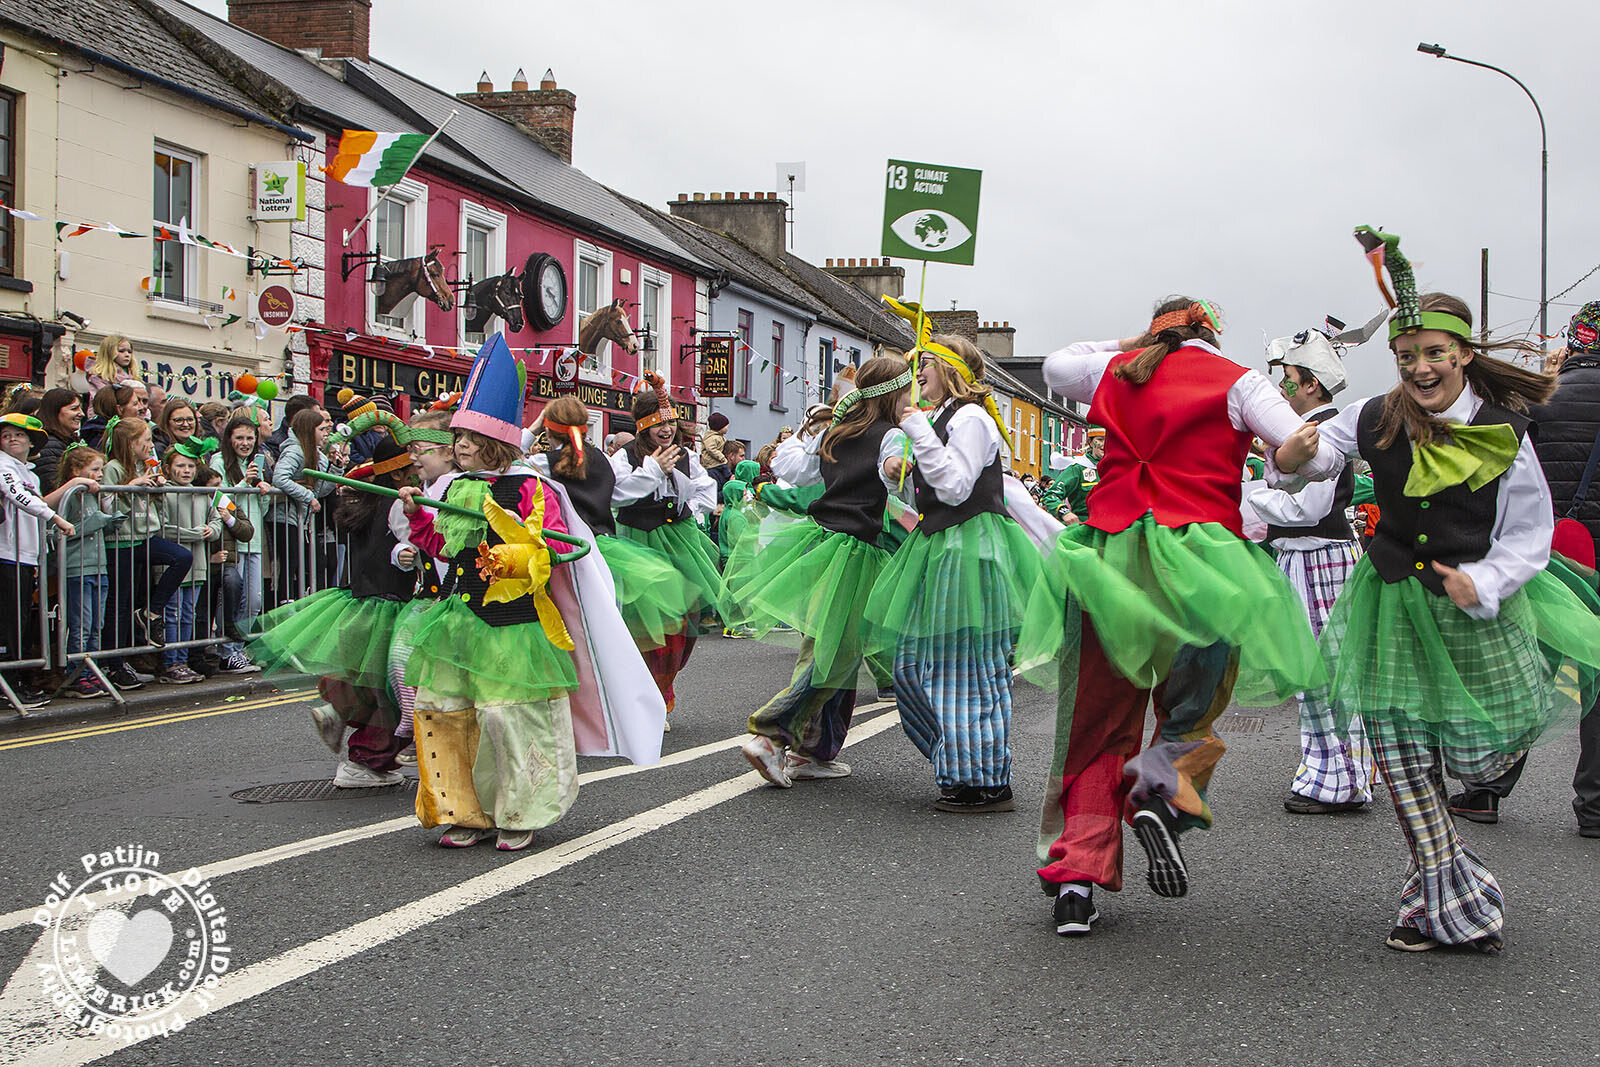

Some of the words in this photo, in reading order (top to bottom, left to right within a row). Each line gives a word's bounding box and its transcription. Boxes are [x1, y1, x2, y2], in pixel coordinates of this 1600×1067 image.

[887, 164, 908, 190] 13
[915, 168, 949, 182] CLIMATE
[913, 181, 944, 195] ACTION
[706, 357, 727, 374] BAR
[343, 354, 404, 391] BILL
[418, 370, 462, 397] CHA
[617, 393, 624, 408] &
